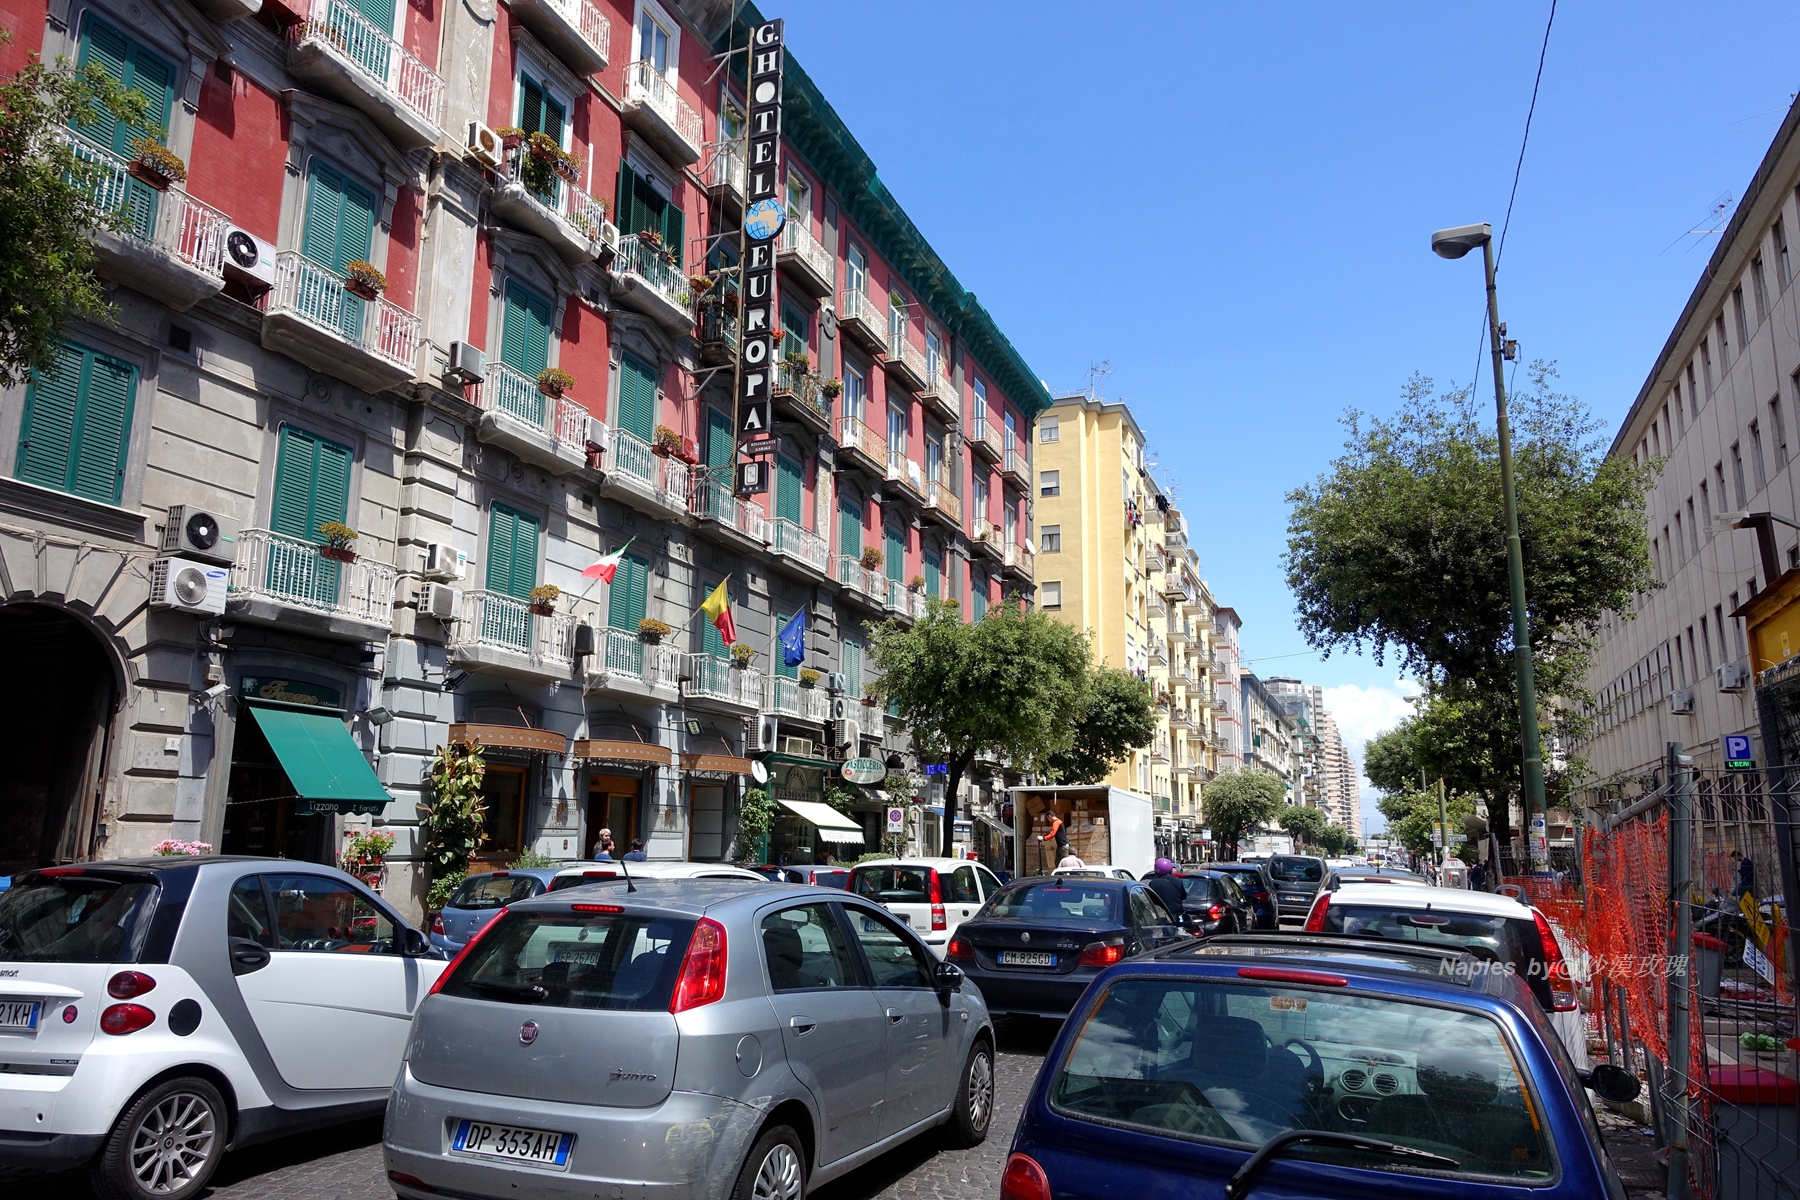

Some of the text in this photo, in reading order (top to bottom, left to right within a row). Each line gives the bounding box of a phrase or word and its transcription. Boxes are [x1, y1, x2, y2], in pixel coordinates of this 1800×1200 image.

[754, 50, 778, 197] HOTEL
[743, 243, 770, 431] EUROPA
[750, 439, 777, 447] RISTORANTE
[1728, 737, 1747, 758] P
[845, 759, 883, 771] PASTICCERIA
[308, 800, 340, 812] Tizzano
[1004, 952, 1051, 965] CM 825GD
[465, 1124, 559, 1161] DP 353AH
